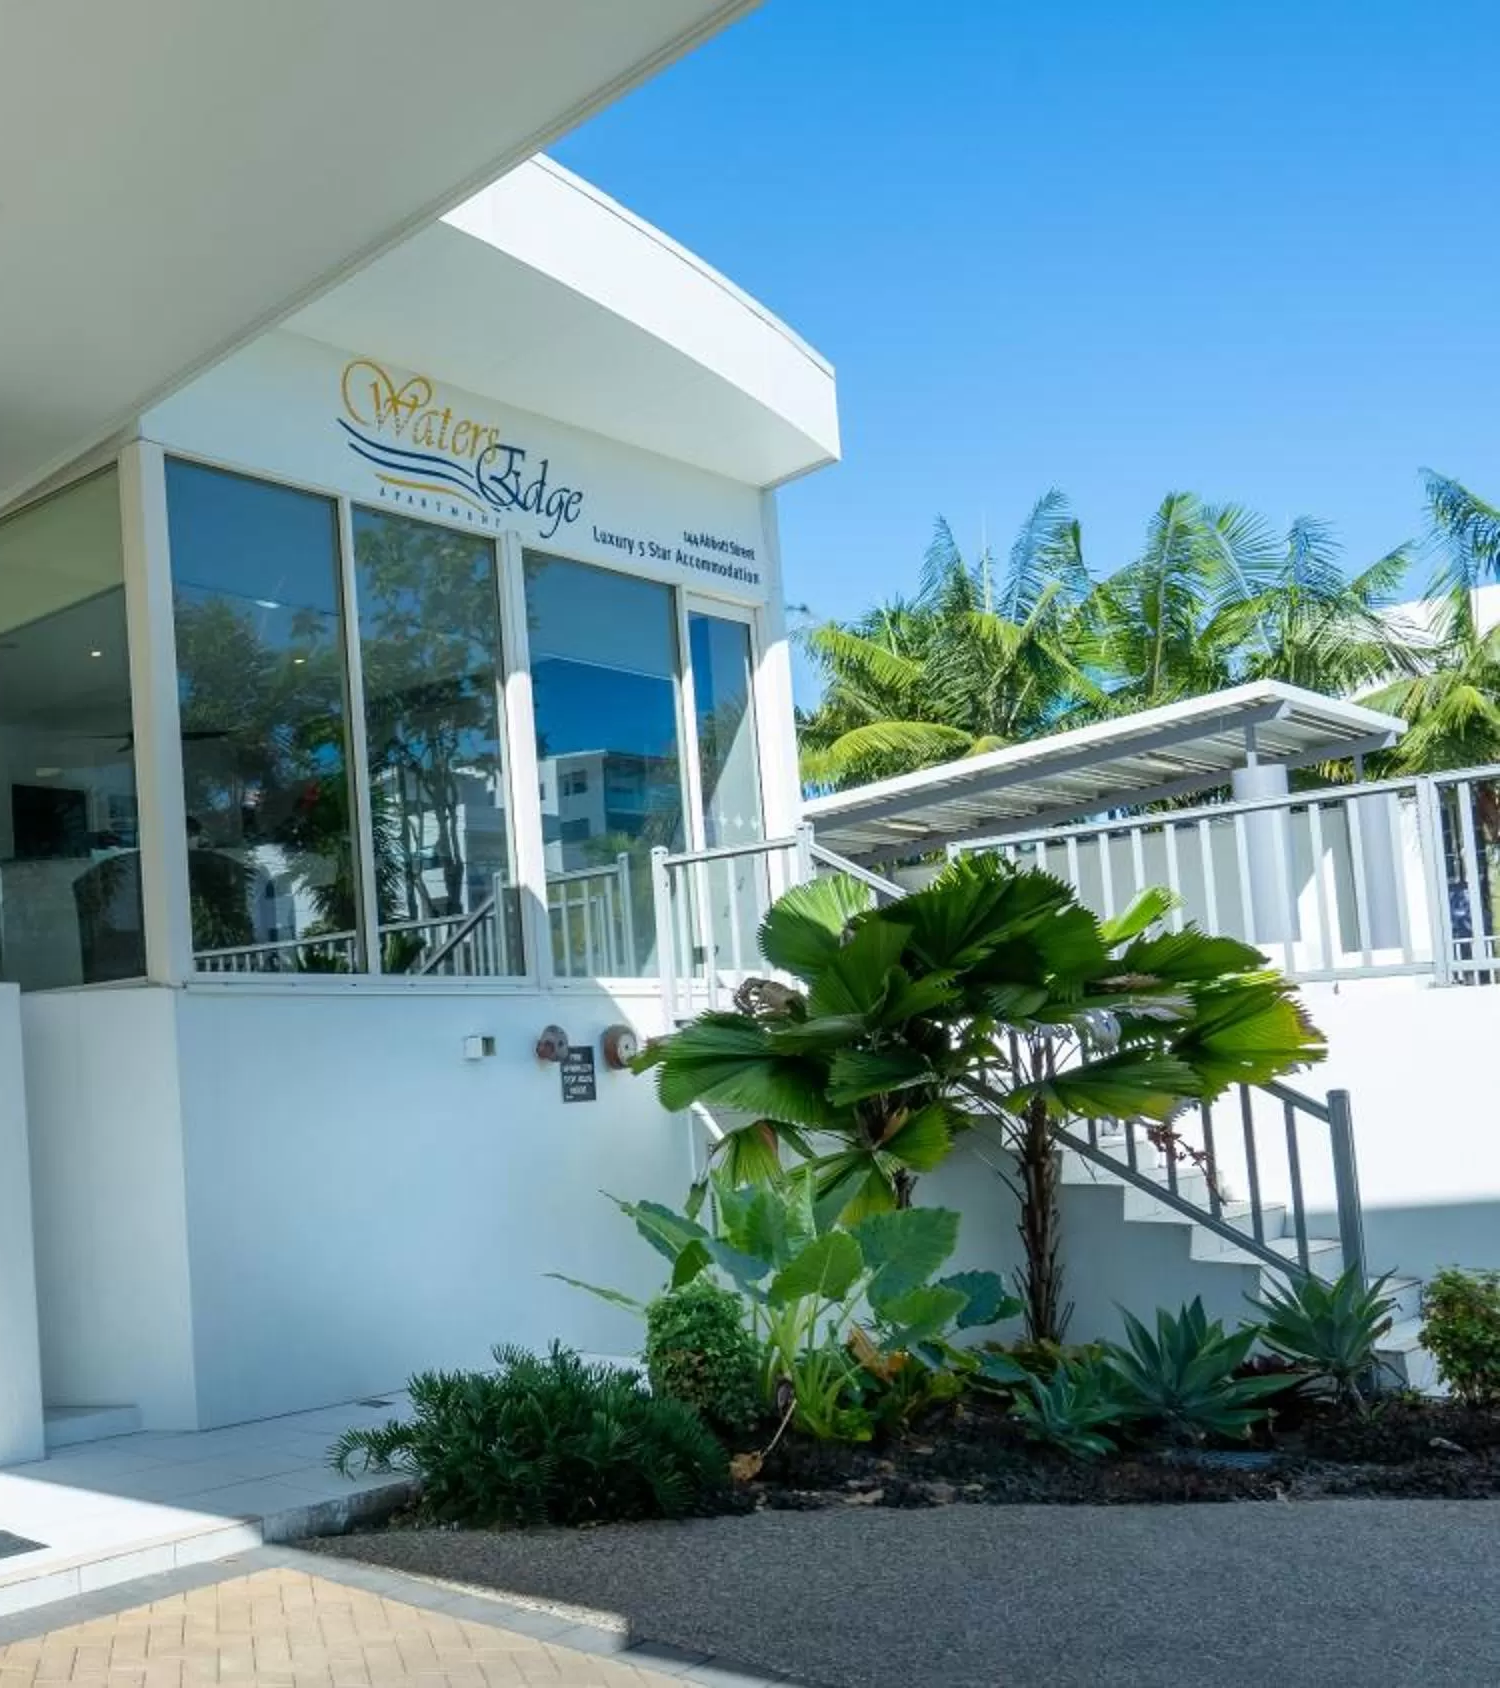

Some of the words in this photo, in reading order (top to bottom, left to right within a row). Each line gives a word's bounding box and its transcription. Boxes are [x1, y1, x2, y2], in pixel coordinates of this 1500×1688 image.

[342, 360, 500, 465] Waters
[476, 443, 583, 539] Edge
[592, 525, 635, 555] Luxury
[638, 540, 645, 557] 5
[649, 540, 672, 561] Star
[675, 548, 761, 585] Accommodation
[729, 540, 756, 561] Street
